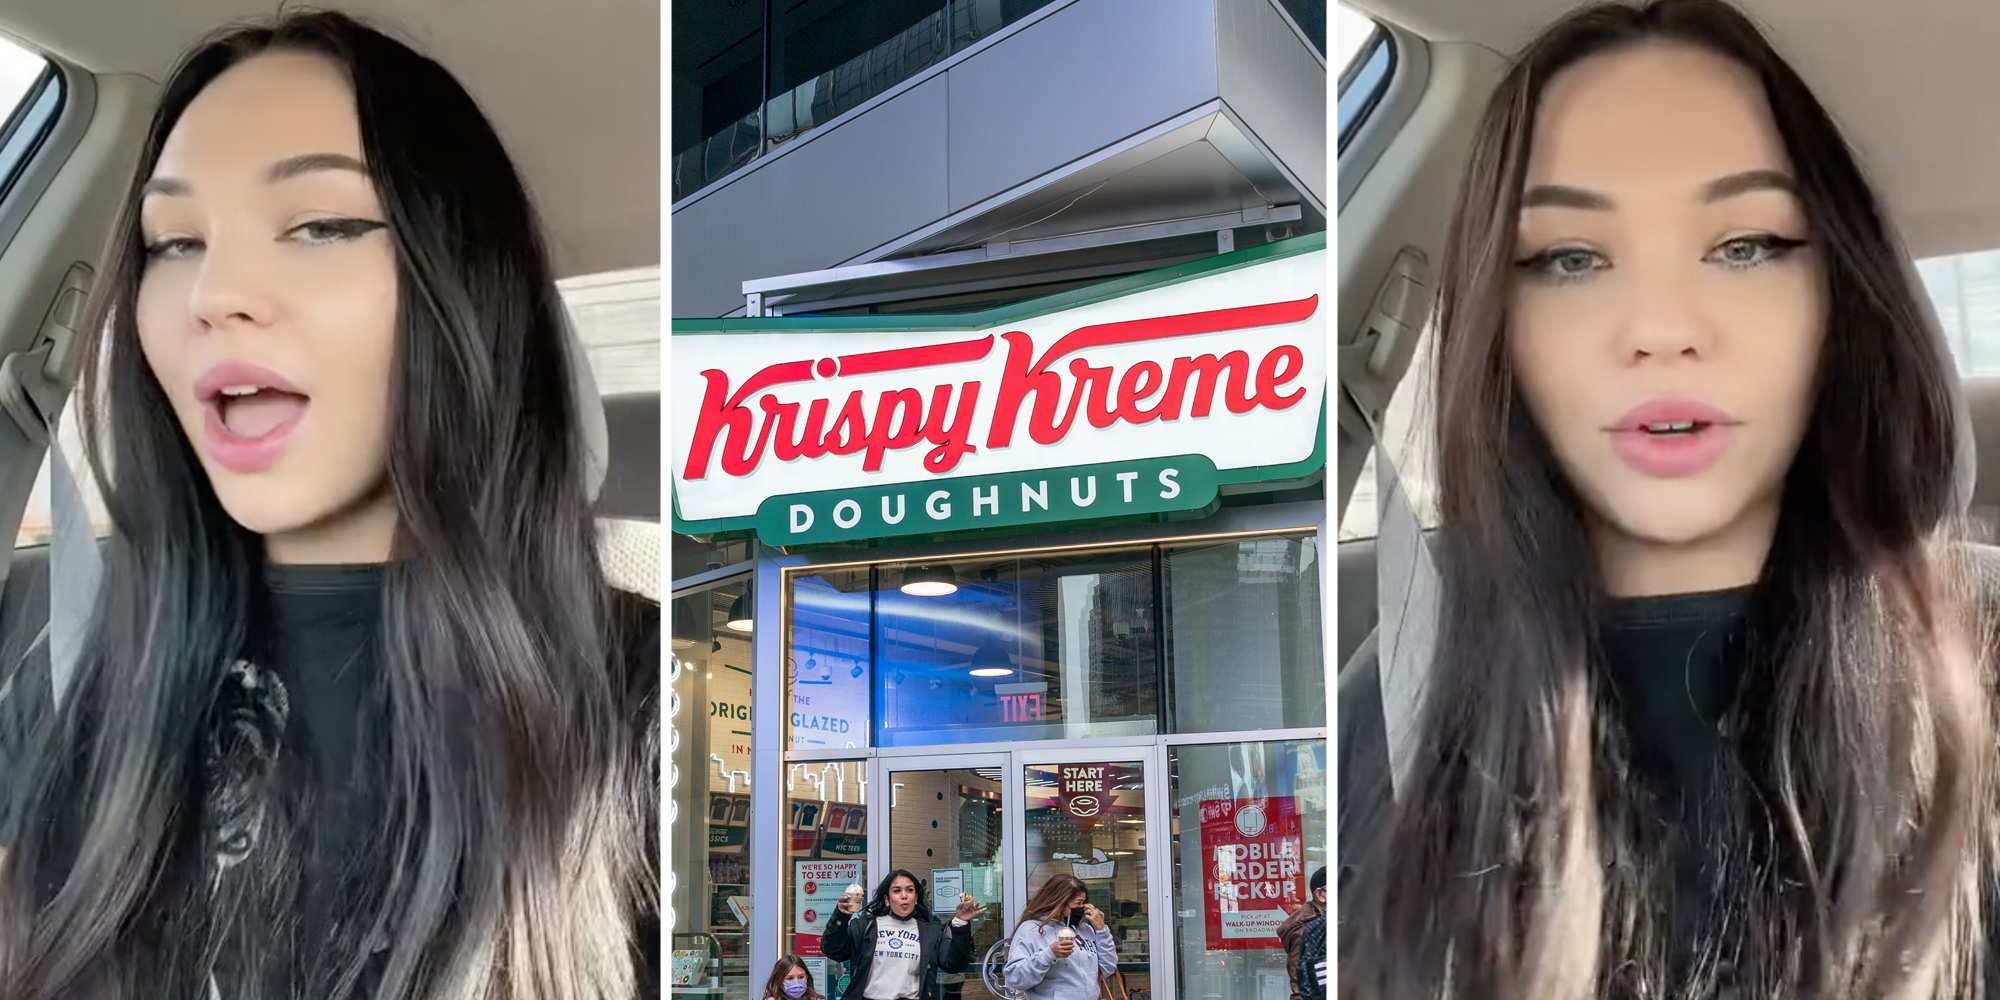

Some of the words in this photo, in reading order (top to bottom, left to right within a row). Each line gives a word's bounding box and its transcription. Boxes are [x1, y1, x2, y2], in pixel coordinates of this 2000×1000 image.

[682, 333, 994, 480] Krispy
[986, 293, 1319, 449] Kreme
[789, 468, 1181, 534] DOUGHNUTS
[793, 694, 810, 706] THE
[790, 712, 850, 734] GLAZED
[732, 743, 743, 755] IN
[1063, 766, 1105, 779] START
[1065, 780, 1103, 792] HERE
[709, 835, 729, 843] SSICS
[1212, 842, 1293, 861] MOBILE
[801, 863, 823, 871] WE'RE
[1212, 861, 1295, 880] ORDER
[801, 871, 815, 880] TO
[815, 871, 832, 879] SEE
[1214, 881, 1297, 900] PICKUP
[877, 930, 895, 938] EW
[904, 952, 920, 961] CITY
